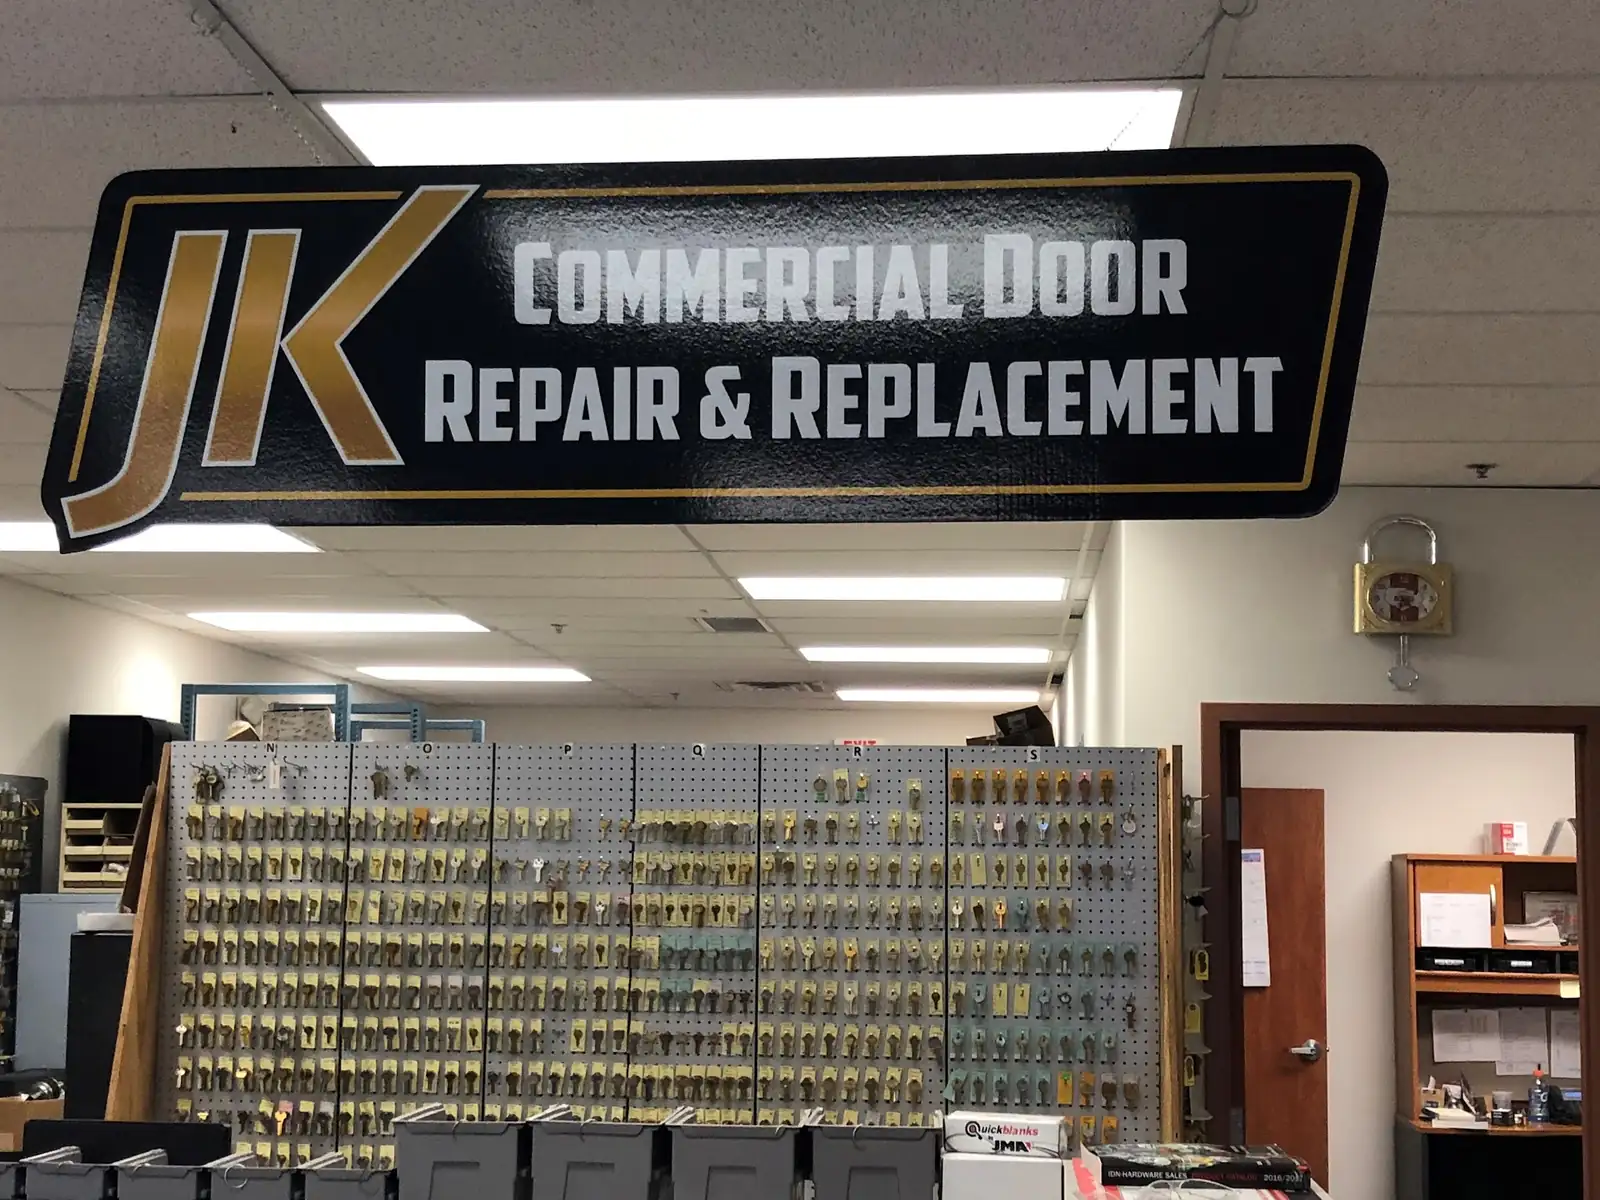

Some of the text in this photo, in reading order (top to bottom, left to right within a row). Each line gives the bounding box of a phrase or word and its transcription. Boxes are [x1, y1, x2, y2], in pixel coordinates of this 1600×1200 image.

[514, 232, 1189, 325] COMMERCIAL DOOR
[61, 184, 481, 540] JK
[423, 355, 1284, 443] REPAIR & REPLACEMENT
[266, 743, 275, 753] N
[564, 745, 572, 755] P
[693, 745, 703, 757] Q
[853, 746, 862, 757] R
[1030, 749, 1038, 760] S
[965, 1121, 1039, 1140] Quickblanks
[992, 1140, 1031, 1152] JMA
